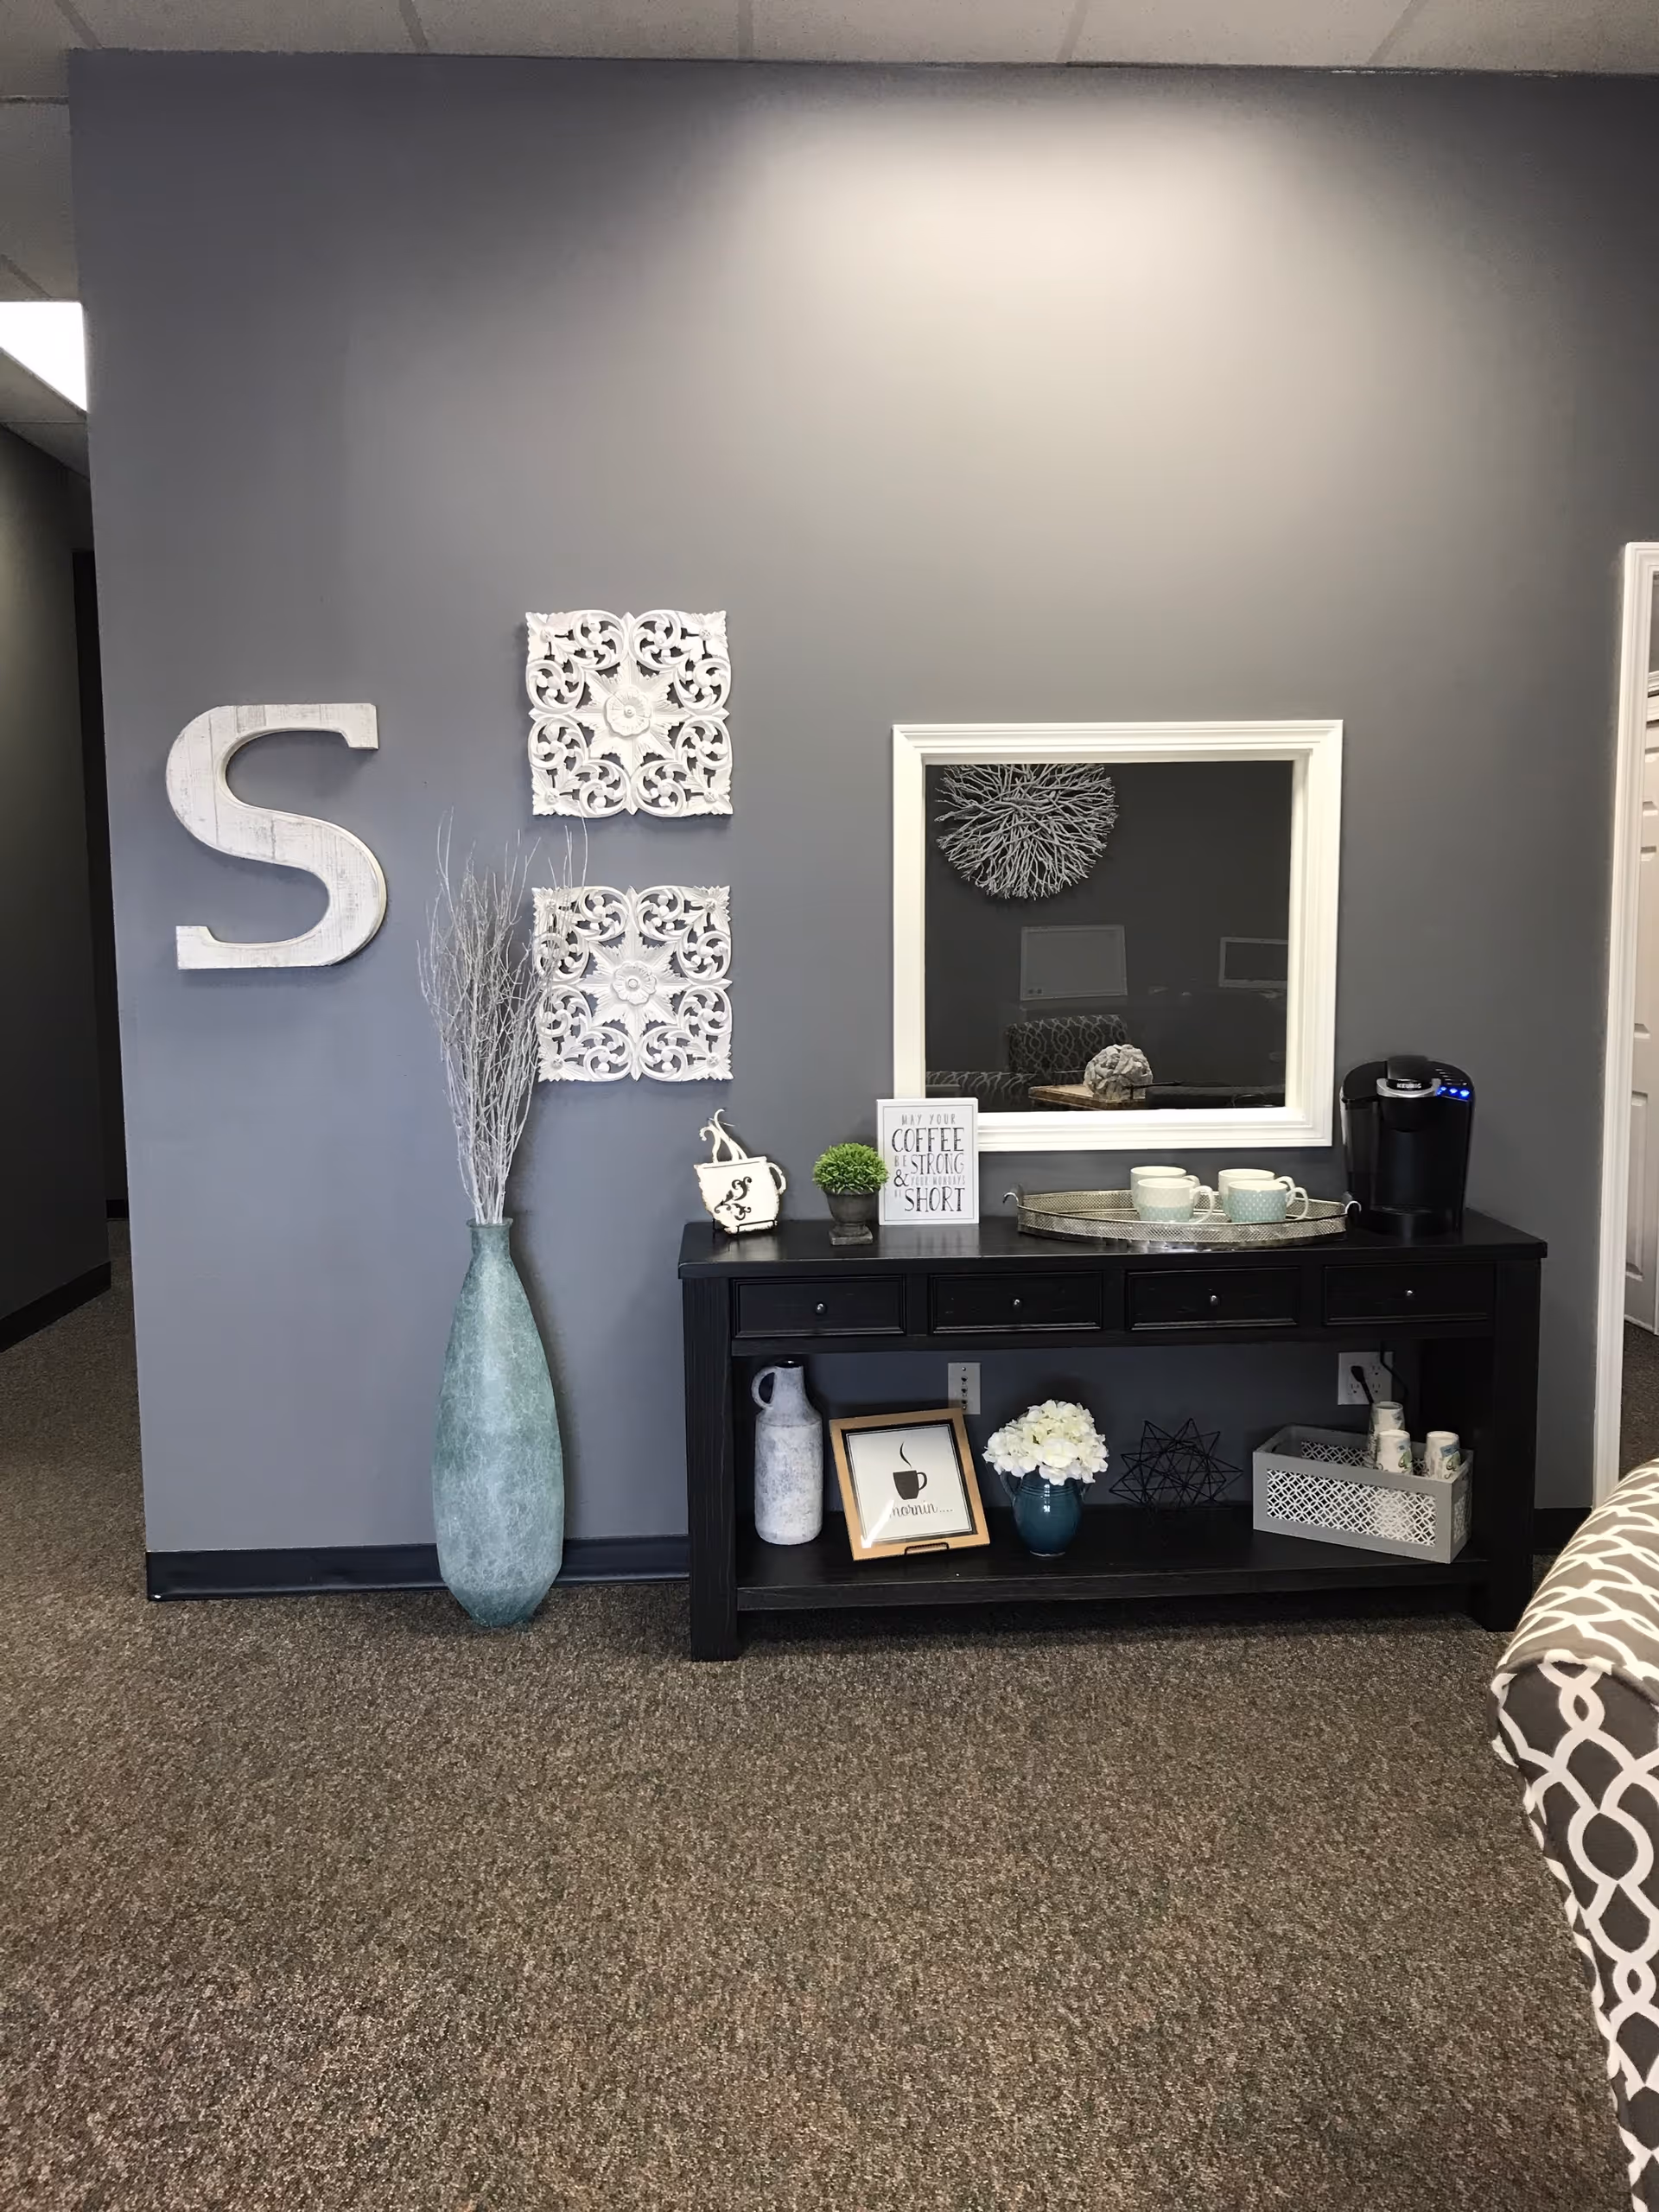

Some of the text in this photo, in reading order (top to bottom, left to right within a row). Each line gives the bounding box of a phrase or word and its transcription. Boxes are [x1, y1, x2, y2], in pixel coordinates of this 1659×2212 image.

[166, 702, 386, 969] S
[901, 1114, 956, 1125] MAY YOUR
[891, 1127, 964, 1153] COFFEE
[894, 1153, 964, 1175] BE STRONG
[893, 1169, 966, 1187] & YOUR MONDAYS
[904, 1186, 965, 1211] SHORT
